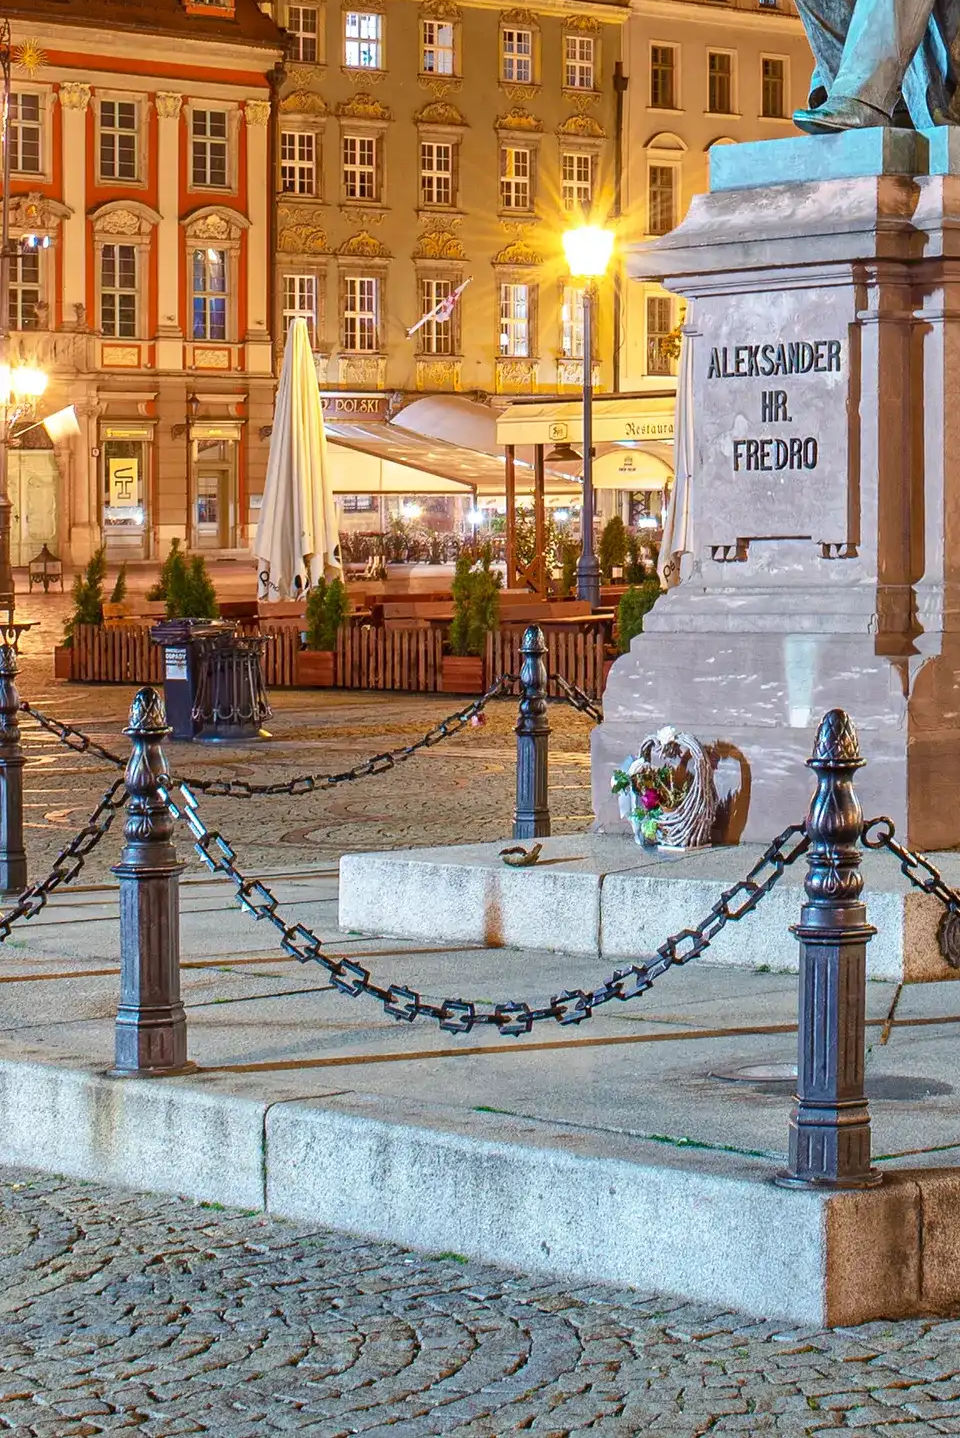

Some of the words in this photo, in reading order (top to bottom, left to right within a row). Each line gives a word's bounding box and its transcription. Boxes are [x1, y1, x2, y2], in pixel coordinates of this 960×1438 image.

[707, 340, 842, 380] ALEKSANDER
[335, 398, 379, 413] POLSKI
[761, 389, 793, 423] HR.
[733, 436, 818, 472] FREDRO
